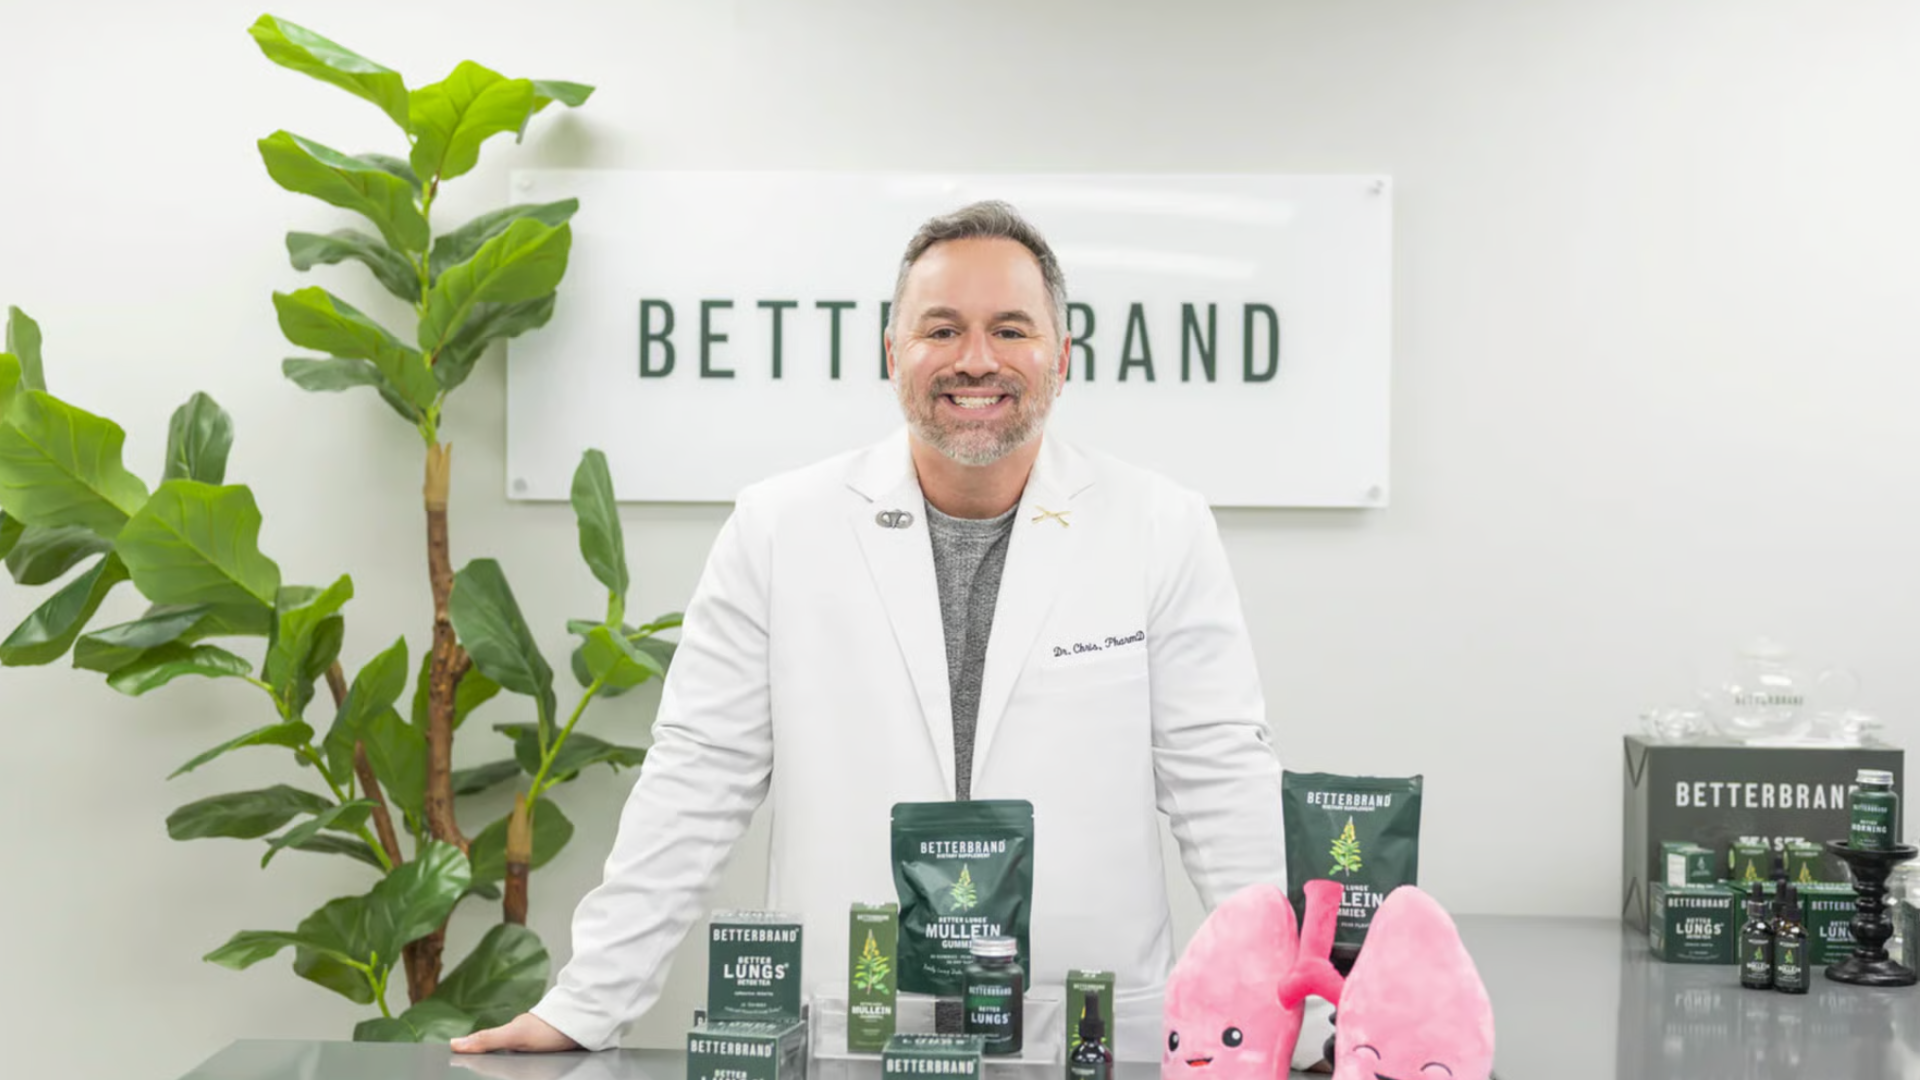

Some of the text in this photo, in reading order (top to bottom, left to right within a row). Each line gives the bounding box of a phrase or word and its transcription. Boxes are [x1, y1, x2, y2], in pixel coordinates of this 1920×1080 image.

[639, 299, 1281, 383] BETTRAND
[1053, 630, 1145, 657] Dr. Chris, PharmD
[1307, 791, 1391, 807] BETTERBRAND
[1676, 781, 1859, 809] BETTERBRAN
[921, 840, 1005, 854] BETTERBRAND
[1340, 892, 1383, 908] LEIN
[1668, 898, 1730, 909] BETTERBRAND
[938, 916, 963, 924] BETTER
[713, 929, 797, 942] BETTERBRAND
[925, 924, 1001, 939] MULLEIN
[1676, 923, 1722, 935] LUNGS
[942, 940, 972, 949] GUMMI
[738, 956, 772, 965] BETTER
[724, 963, 786, 980] LUNGS
[971, 1012, 1009, 1025] LUNGS
[691, 1039, 772, 1058] BETTERBRAND
[887, 1058, 974, 1075] BETTERBRAND
